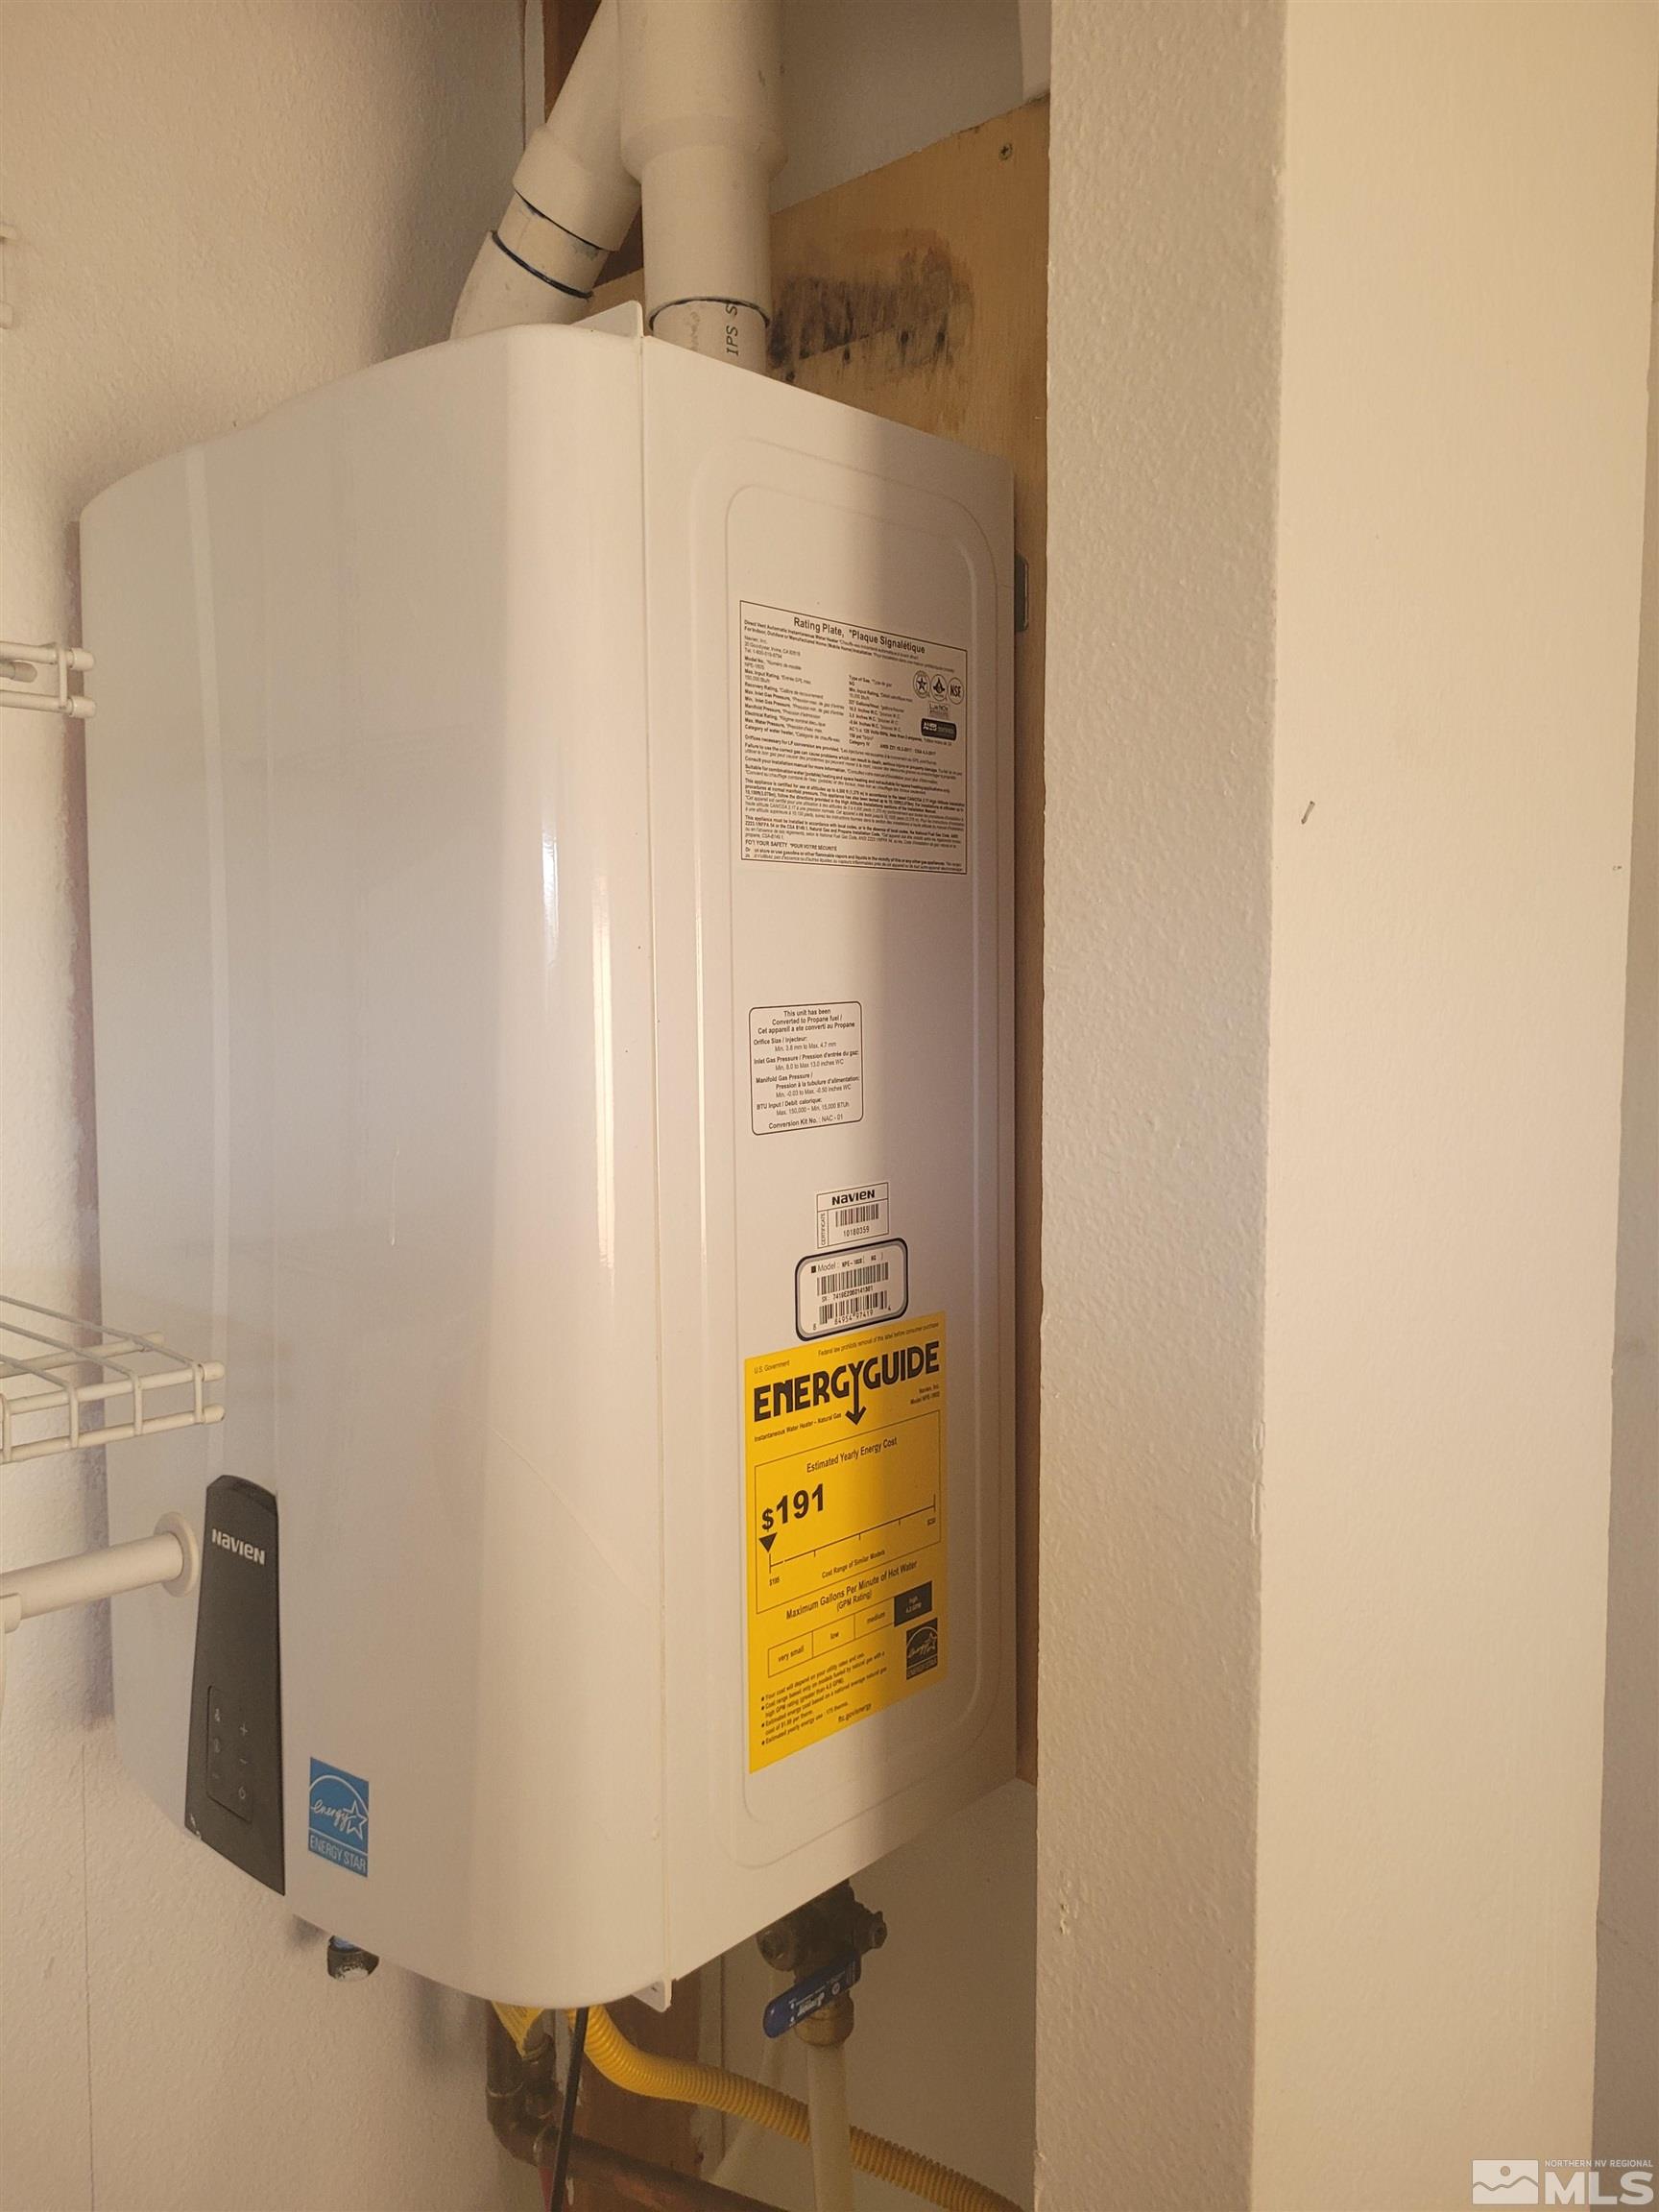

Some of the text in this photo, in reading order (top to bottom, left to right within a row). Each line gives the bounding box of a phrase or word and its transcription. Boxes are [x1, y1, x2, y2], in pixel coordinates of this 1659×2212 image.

[726, 325, 738, 356] IPS
[793, 616, 820, 633] Rating
[822, 622, 844, 637] Plate,
[879, 635, 925, 656] Signalétique
[768, 1025, 790, 1034] appareil
[771, 1017, 799, 1025] Converted
[806, 1015, 828, 1024] Propane
[756, 1075, 777, 1084] Manifold
[788, 1071, 809, 1080] Pressure
[768, 1100, 781, 1109] Input
[768, 1118, 799, 1130] Conversion
[821, 1114, 832, 1122] NAC
[843, 1225, 869, 1238] 10180359
[763, 1359, 789, 1372] Government
[754, 1428, 785, 1443] Instantaneous
[785, 1424, 799, 1433] Water
[799, 1419, 813, 1430] Heater
[817, 1414, 832, 1425] Natural
[832, 1411, 841, 1420] Gas
[806, 1435, 897, 1473] Estimated Yearly Energy Cost
[760, 1481, 824, 1534] $191
[821, 1568, 832, 1578] Cost
[833, 1562, 847, 1575] Range
[854, 1554, 869, 1566] Similar
[870, 1548, 885, 1559] Models
[785, 1558, 918, 1620] Maximum Gallons Per Minute of Hot Water
[836, 1588, 872, 1612] (GPM Rating)
[866, 1610, 885, 1624] medium
[830, 1629, 839, 1640] low
[778, 1644, 804, 1664] very small
[309, 1836, 368, 1871] ENERGY STAR
